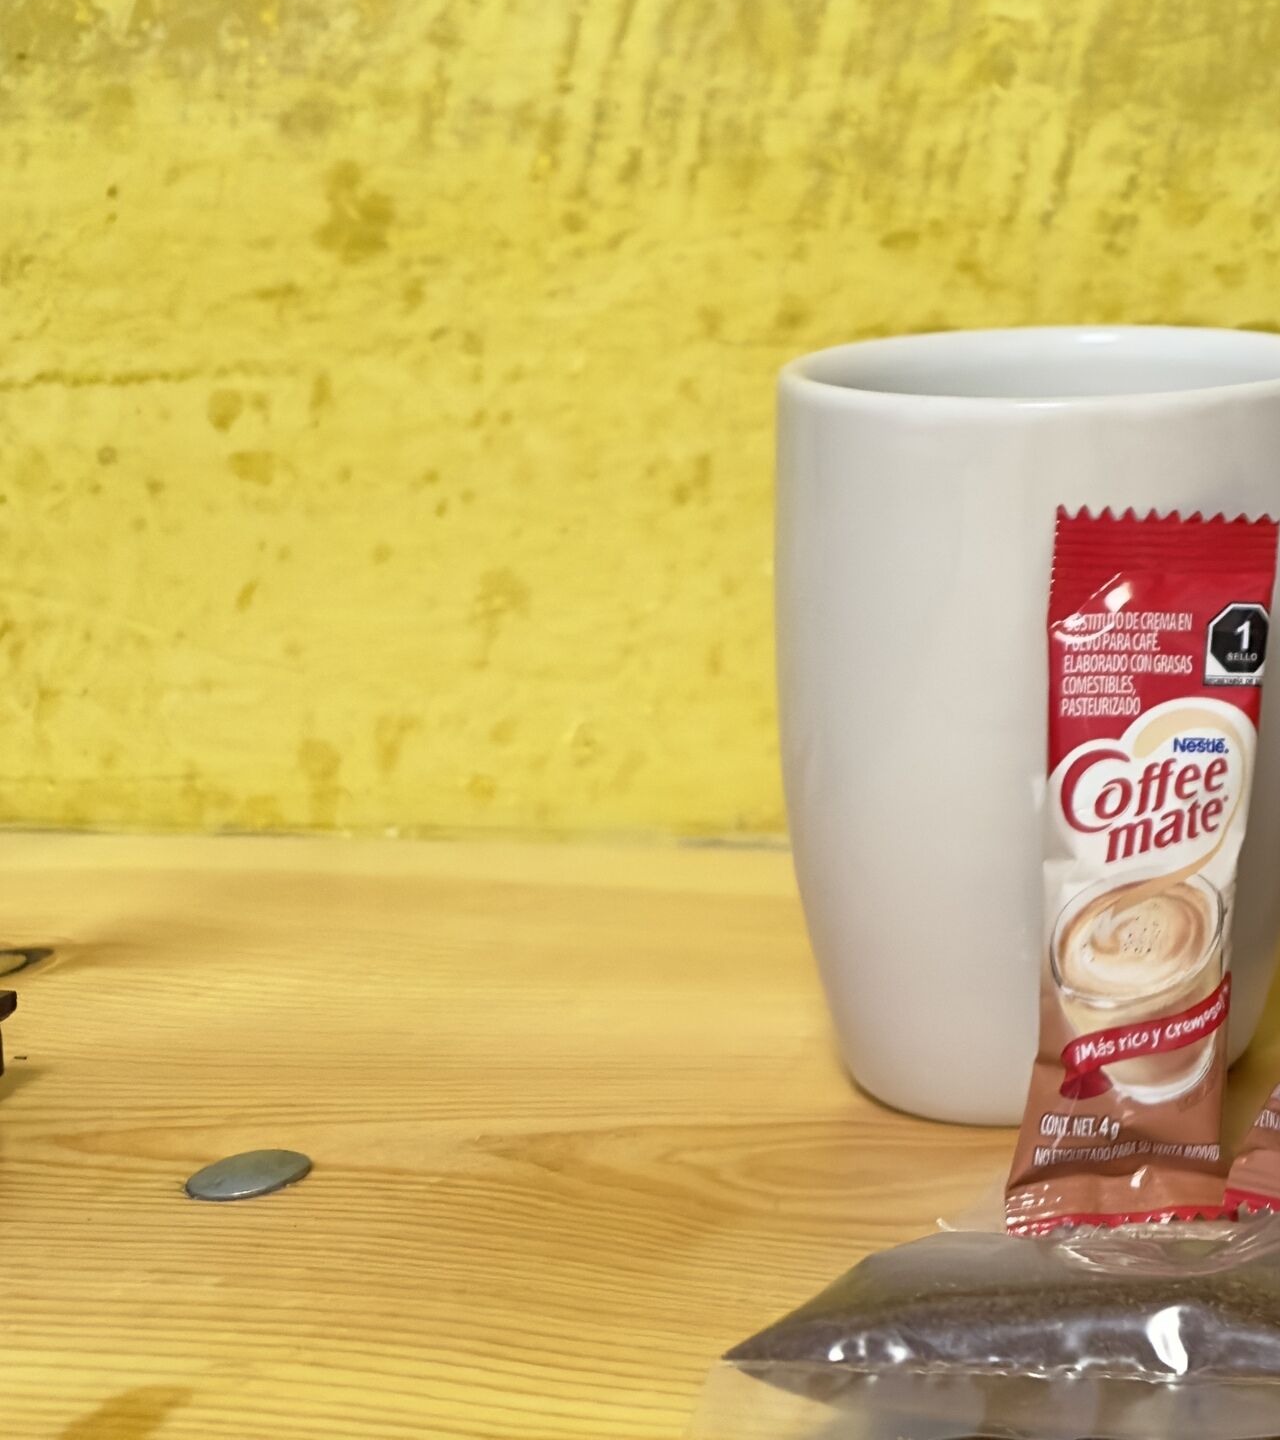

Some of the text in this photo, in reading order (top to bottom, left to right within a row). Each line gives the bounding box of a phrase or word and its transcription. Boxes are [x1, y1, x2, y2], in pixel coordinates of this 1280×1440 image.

[1125, 611, 1140, 630] DE
[1140, 611, 1177, 630] CREMA
[1178, 612, 1193, 631] EN
[1102, 632, 1132, 651] PARA
[1235, 620, 1251, 651] 1
[1063, 653, 1194, 675] ELABORADO CON GRASAS
[1226, 651, 1259, 662] SELLO
[1062, 675, 1136, 696] COMESTIBLES,
[1061, 696, 1141, 716] PASTEURIZADO
[1061, 749, 1229, 833] Coffee
[1105, 798, 1224, 863] mate
[1119, 1031, 1150, 1052] rico
[1149, 1028, 1162, 1049] y
[1072, 1115, 1097, 1138] NET.
[1099, 1116, 1109, 1137] 4
[1110, 1121, 1121, 1141] g
[1034, 1146, 1050, 1167] NO
